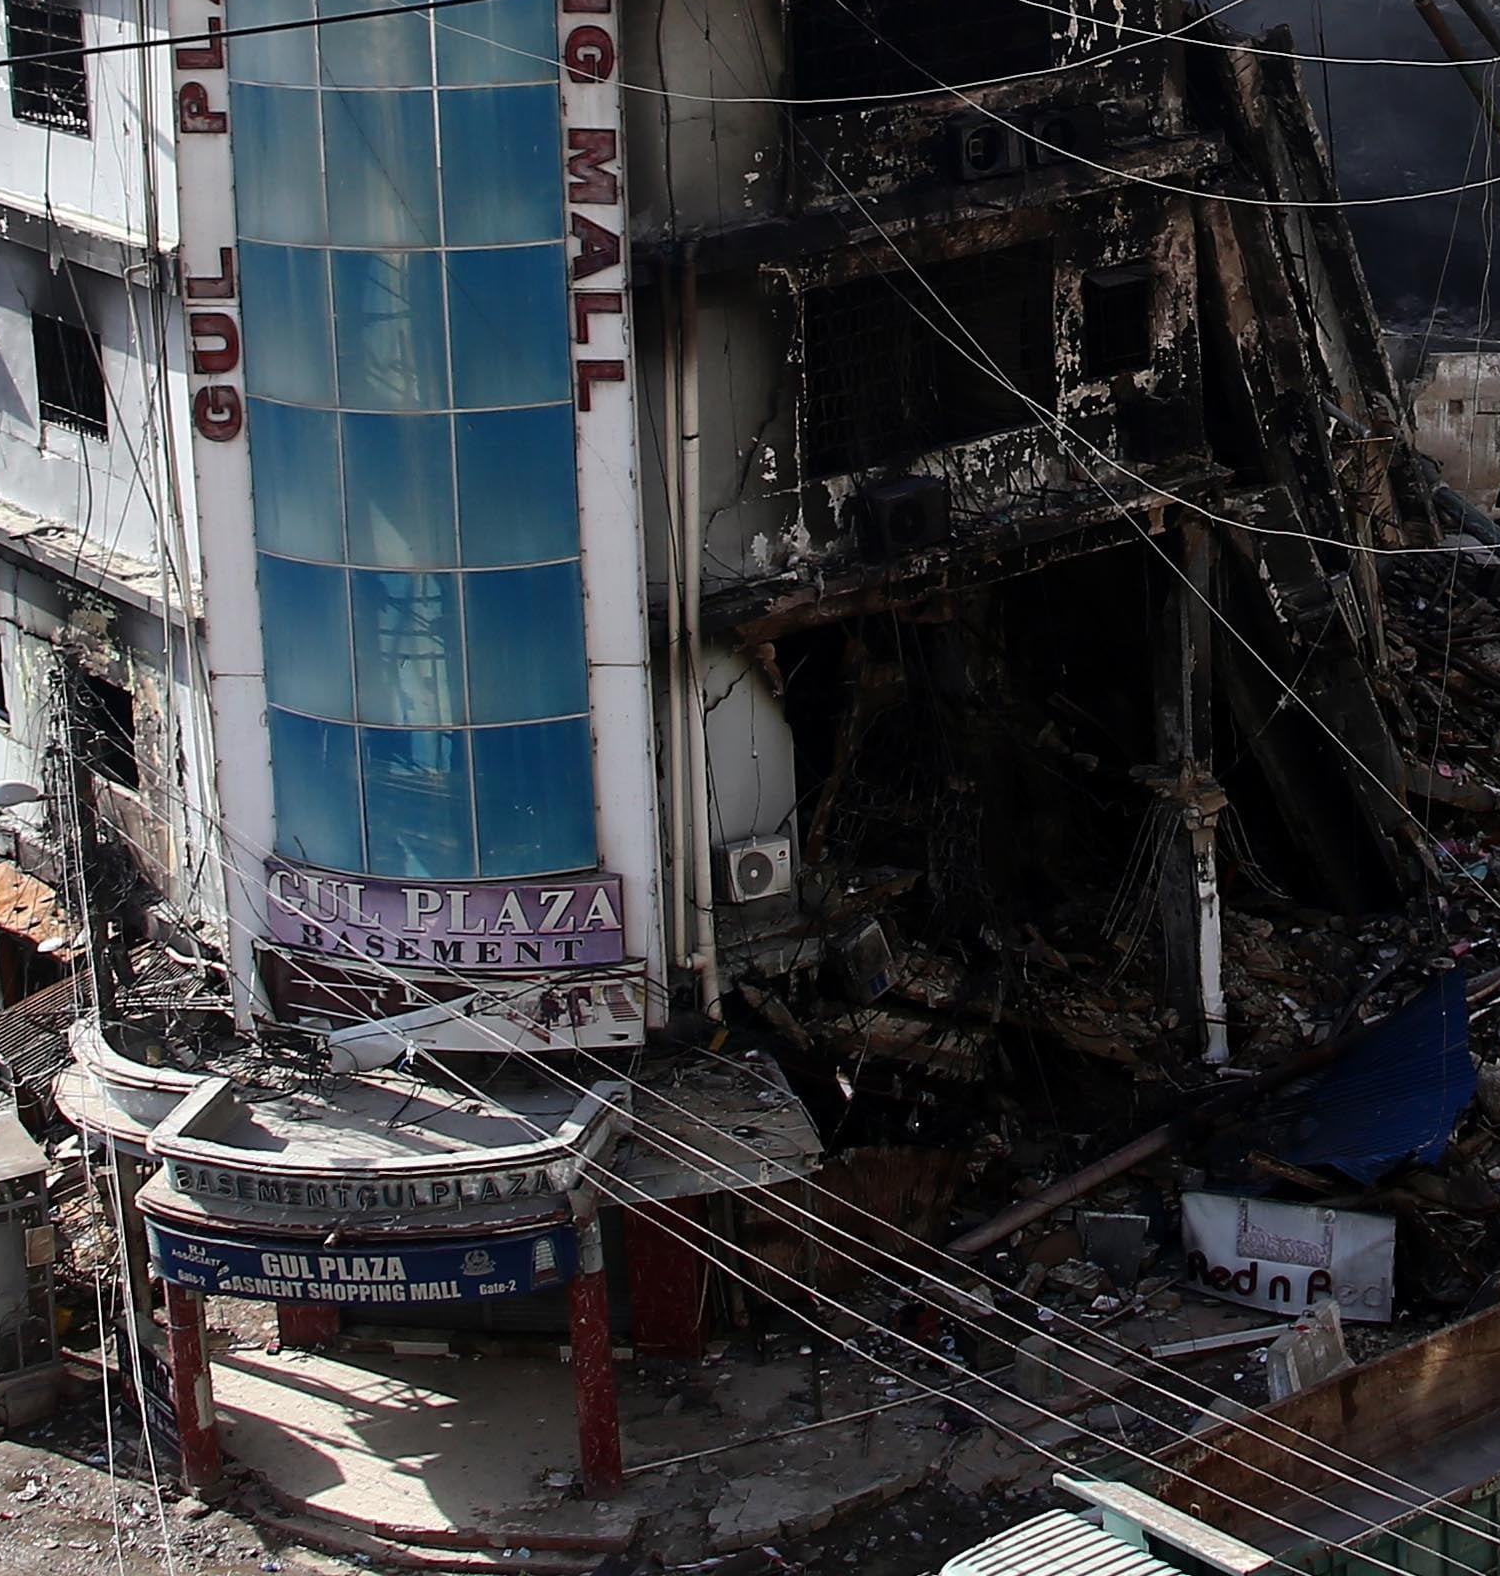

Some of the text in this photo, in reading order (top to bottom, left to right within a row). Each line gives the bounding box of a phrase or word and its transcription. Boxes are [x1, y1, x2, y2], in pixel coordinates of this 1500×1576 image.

[187, 246, 242, 442] GUL
[567, 128, 625, 412] MALL
[268, 870, 623, 936] GUL PLAZA
[301, 923, 584, 964] BASEMENT
[261, 1252, 407, 1281] GUL PLAZA
[1187, 1250, 1258, 1295] Red
[1268, 1275, 1291, 1302] n
[219, 1276, 462, 1302] BASMENT SHOPPING MALL
[479, 1279, 517, 1296] Gate-2
